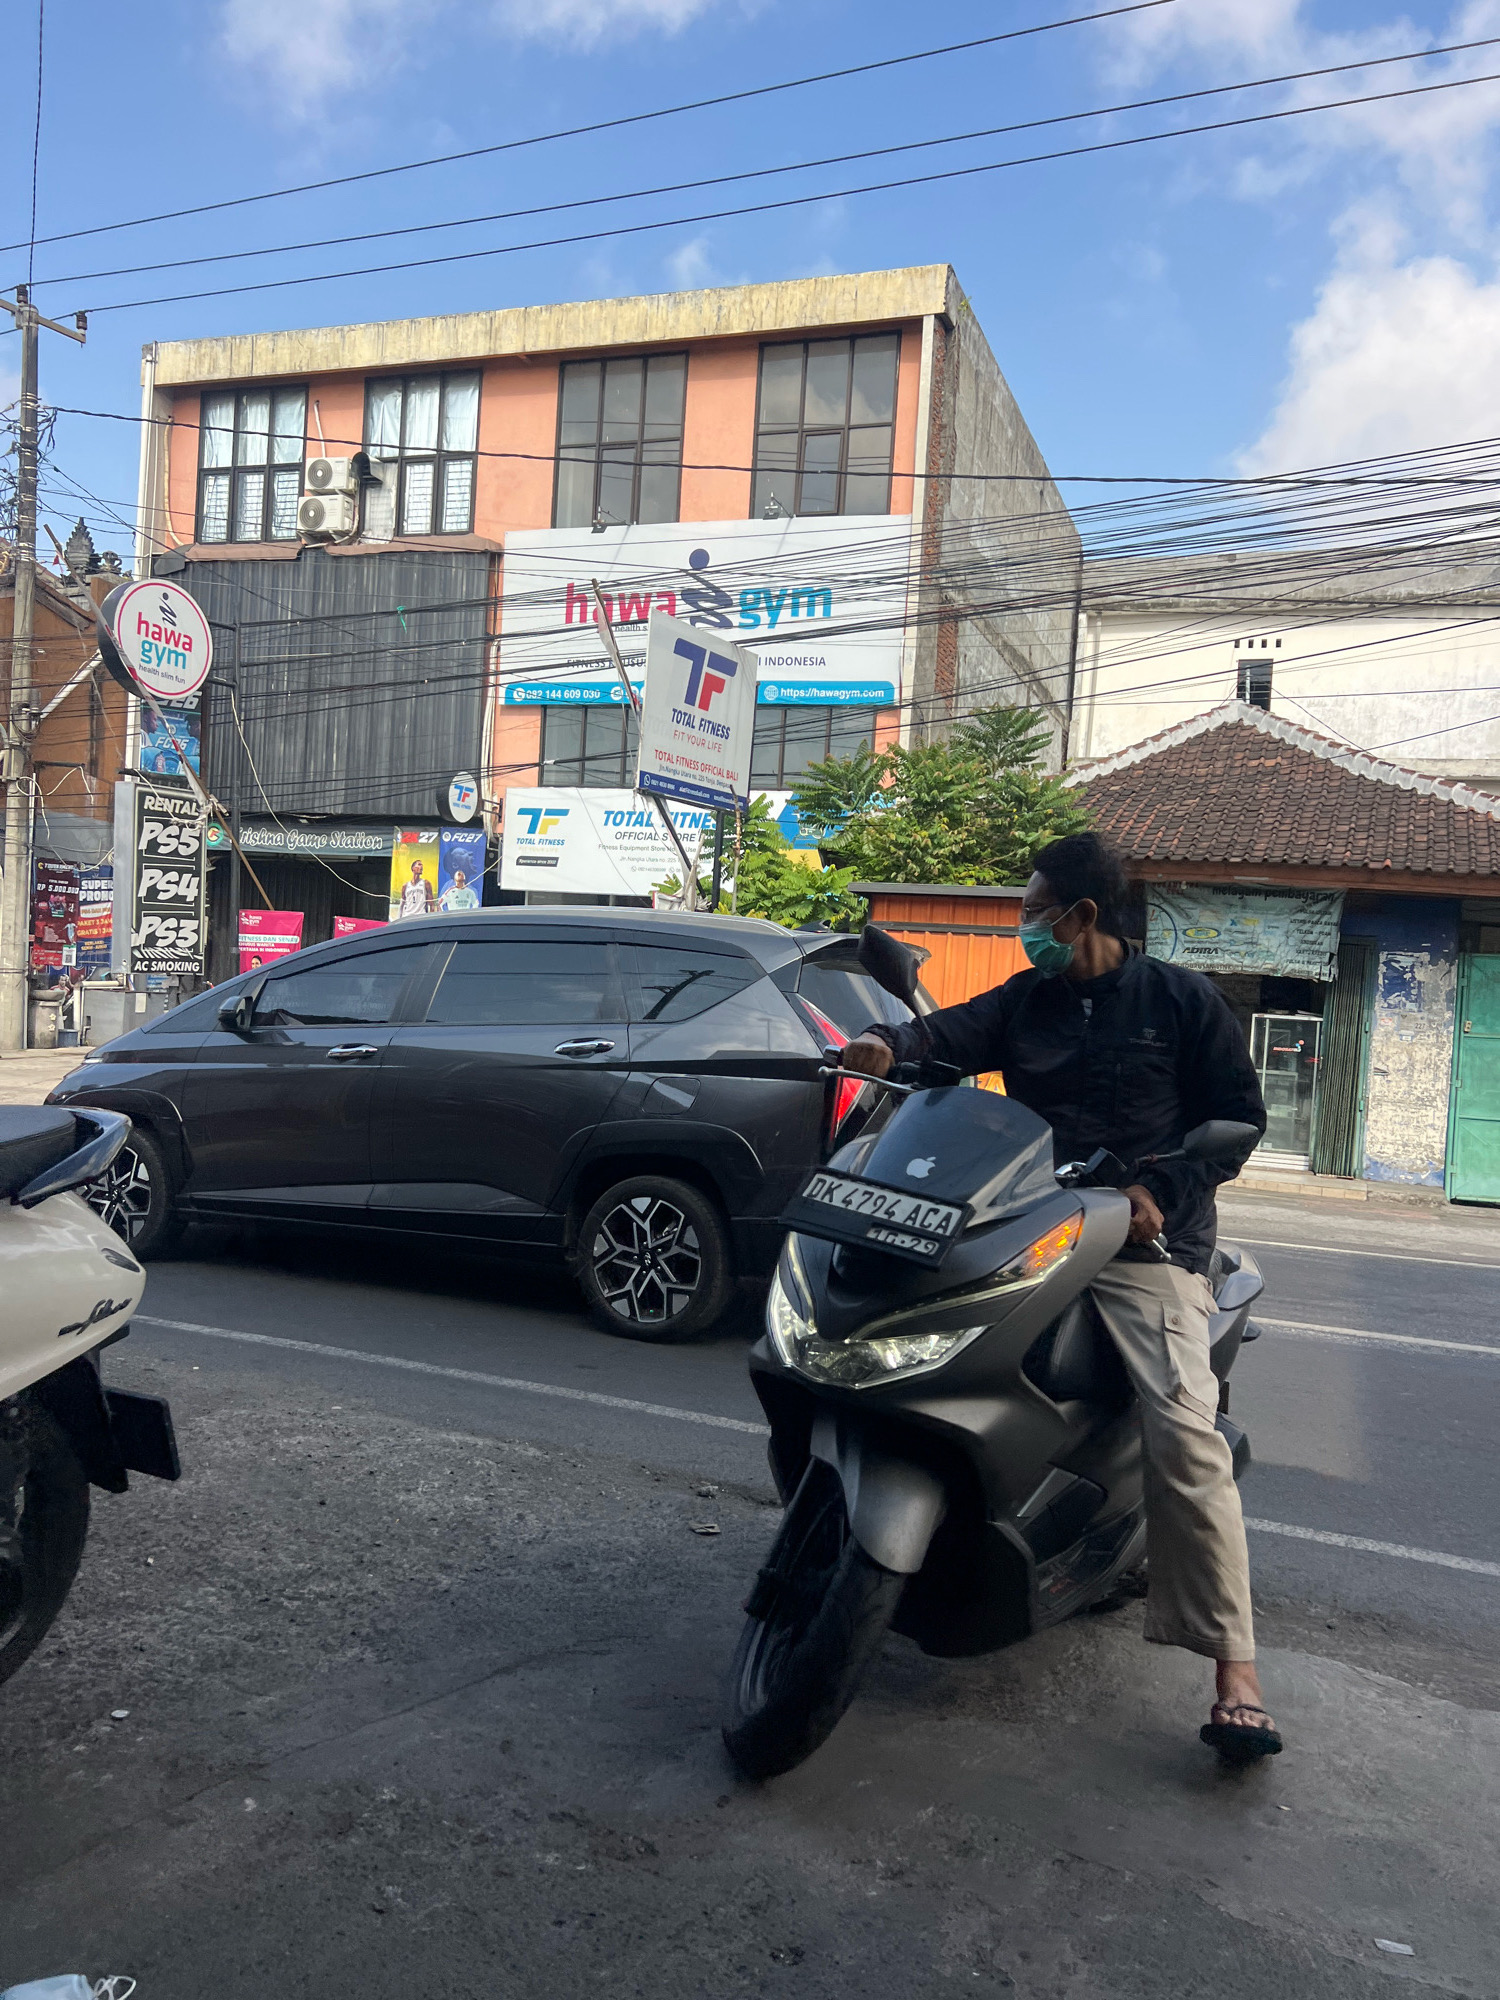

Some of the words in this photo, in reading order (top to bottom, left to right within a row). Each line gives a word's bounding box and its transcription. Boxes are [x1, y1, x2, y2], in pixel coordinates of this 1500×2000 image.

[565, 583, 677, 624] hawa
[738, 586, 832, 630] gym
[137, 611, 193, 652] hawa
[140, 640, 187, 669] gym
[765, 656, 826, 667] INDONESIA
[139, 664, 160, 676] health
[161, 671, 174, 680] slim
[175, 675, 186, 684] fun
[545, 689, 562, 699] 144
[564, 689, 581, 699] 609
[781, 687, 885, 700] https://hawagym.com
[671, 707, 696, 730] TOTAL
[698, 717, 731, 740] FITNESS
[673, 729, 686, 741] FIT
[687, 733, 706, 747] YOUR
[707, 742, 723, 753] LIFE
[654, 749, 675, 765] TOTAL
[675, 755, 700, 771] FITNESS
[700, 762, 725, 778] OFFICIAL
[726, 770, 739, 782] BALI
[143, 795, 199, 816] RENTAL
[603, 810, 654, 828] TOTAL
[138, 821, 201, 856] PS5
[286, 829, 328, 850] Game
[330, 831, 383, 849] Station
[450, 832, 483, 843] FC27
[516, 837, 536, 845] TOTAL
[537, 838, 566, 846] FITNESS
[614, 831, 661, 841] OFFICIAL
[619, 845, 650, 853] Equipment
[137, 868, 200, 902] PS4
[138, 915, 200, 948] PS3
[1182, 947, 1219, 955] ADIRA
[134, 960, 149, 971] AC
[150, 961, 201, 972] SMOKING
[806, 1177, 842, 1203] DK
[841, 1187, 902, 1221] 4794
[903, 1203, 954, 1237] ACA
